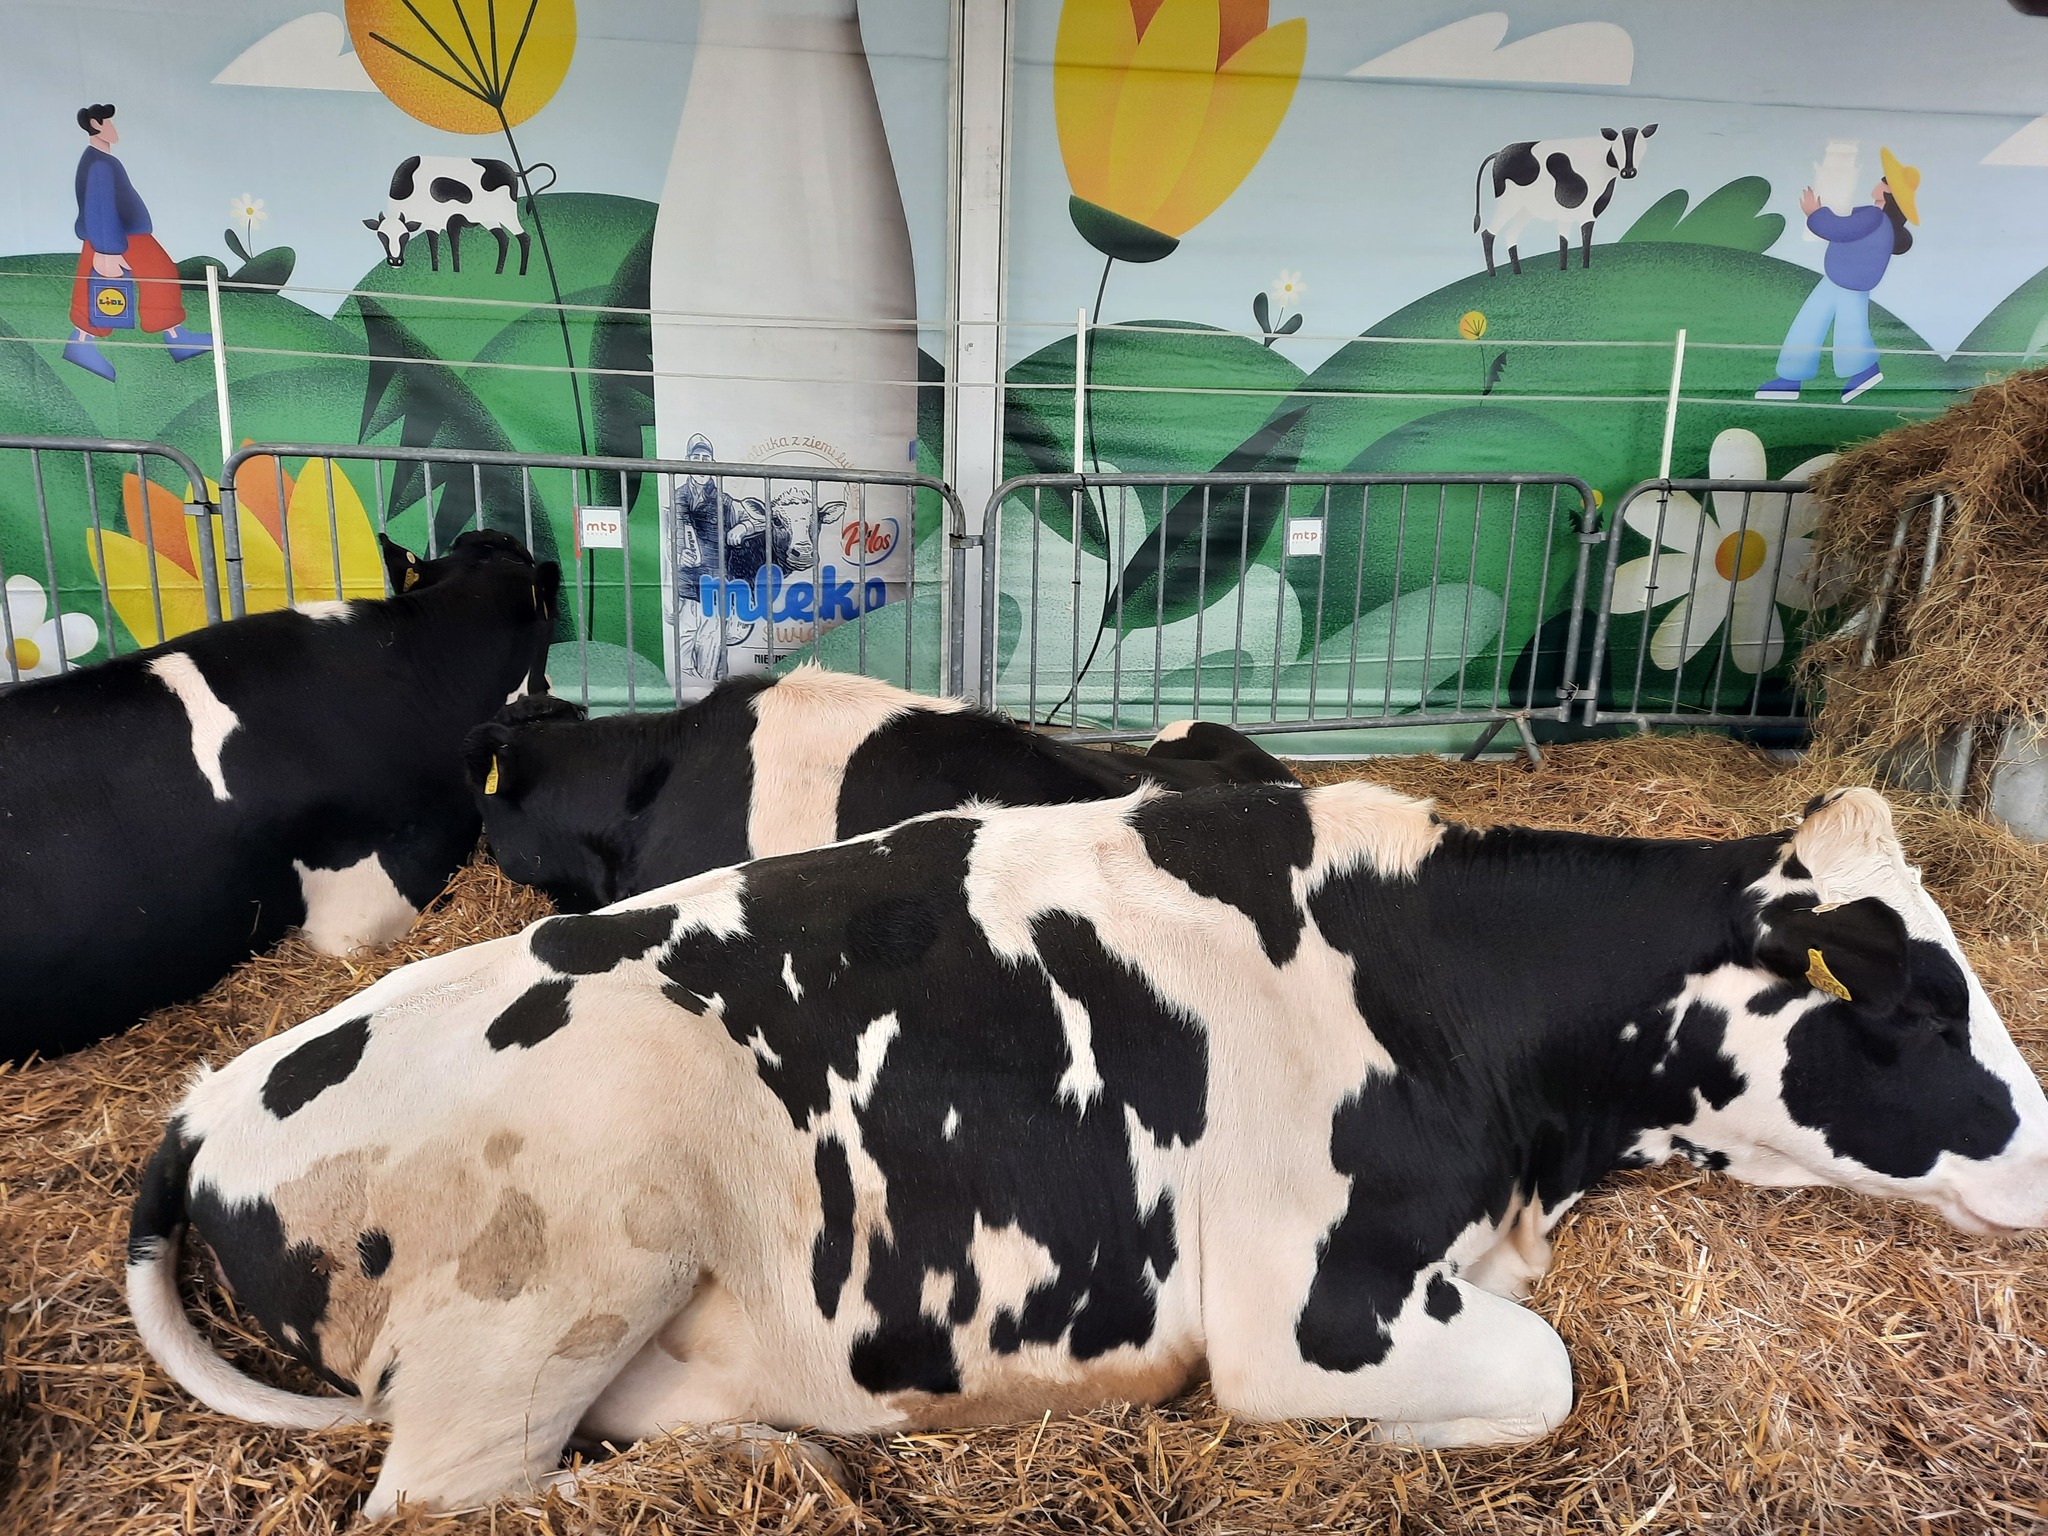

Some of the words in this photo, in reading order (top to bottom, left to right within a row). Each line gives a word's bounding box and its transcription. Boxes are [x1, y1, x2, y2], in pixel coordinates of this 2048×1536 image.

[791, 436, 800, 446] z
[802, 435, 838, 457] ziemi
[586, 521, 618, 534] mtp
[1292, 531, 1318, 541] mtp
[700, 564, 886, 623] mleko
